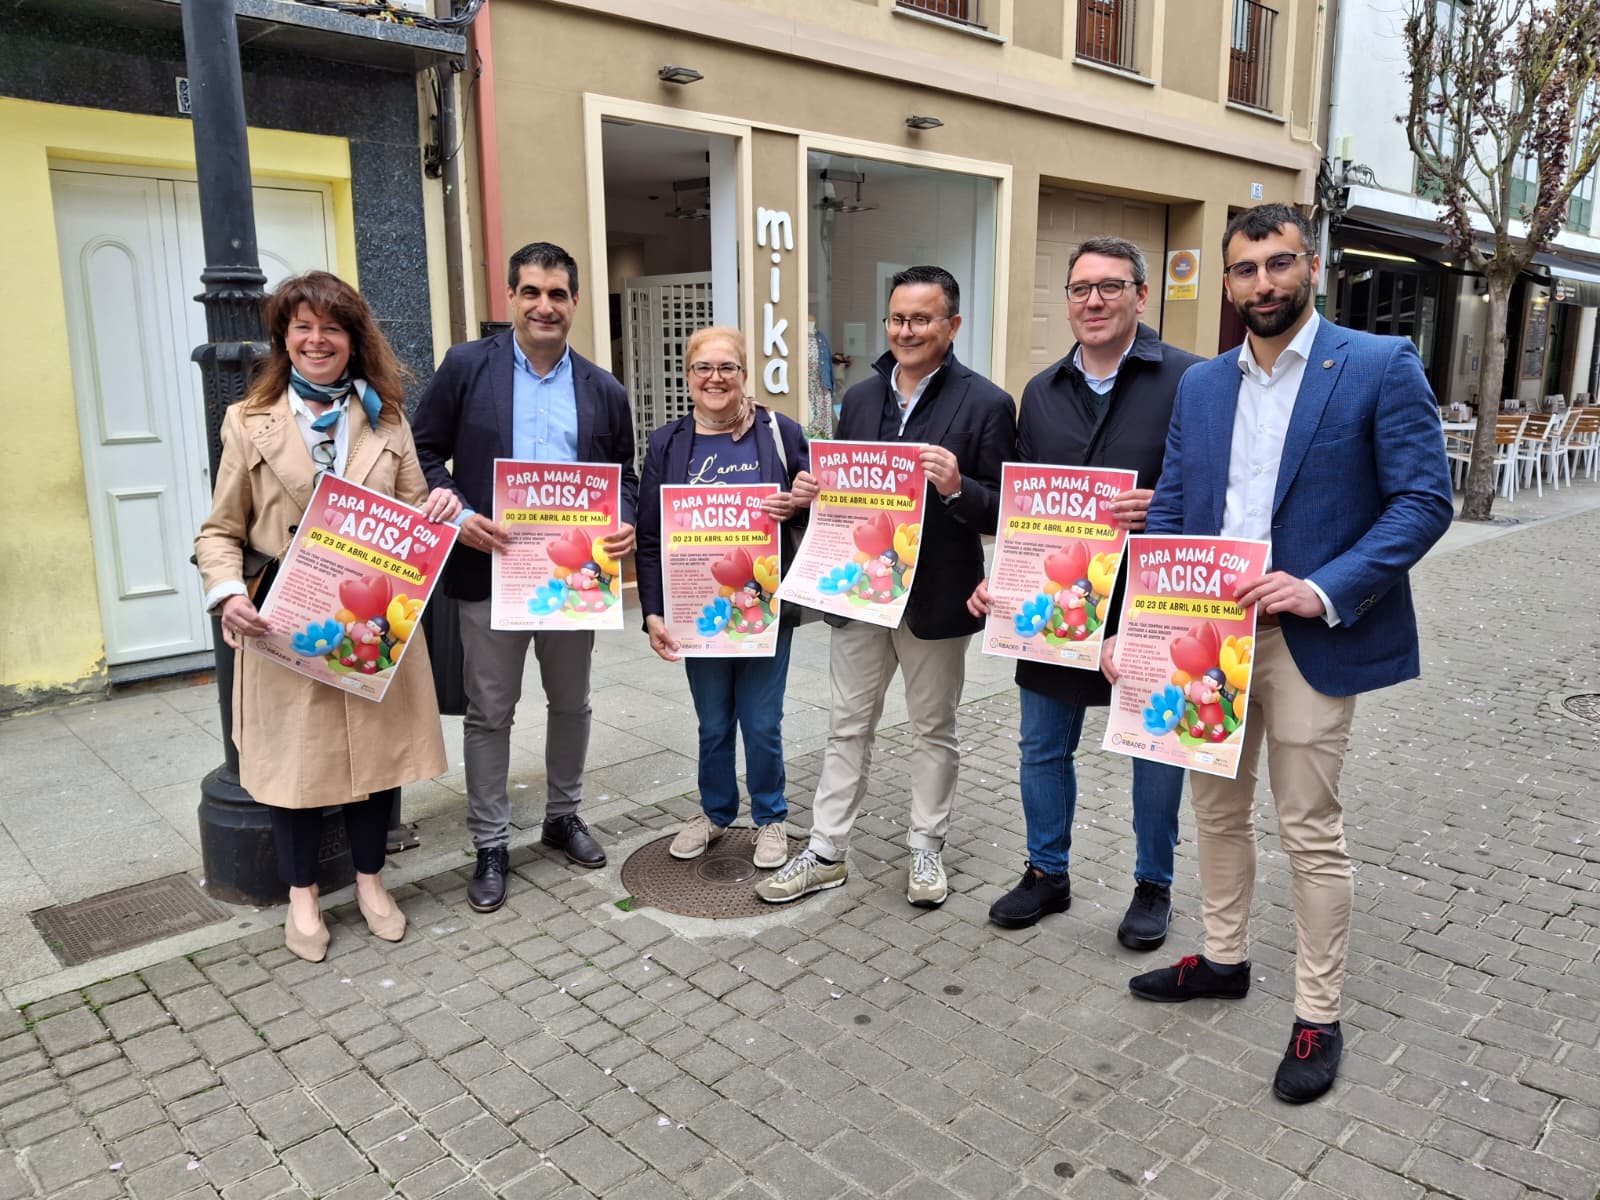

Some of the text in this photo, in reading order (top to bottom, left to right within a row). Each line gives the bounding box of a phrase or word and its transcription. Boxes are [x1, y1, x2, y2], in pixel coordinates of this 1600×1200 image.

[756, 206, 793, 395] mika
[819, 450, 915, 472] PARA MAMÁ CON
[506, 470, 608, 490] PARA MAMÁ CON
[837, 466, 896, 492] ACISA
[1014, 476, 1120, 498] PARA MAMÁ CON
[526, 485, 588, 509] ACISA
[672, 495, 702, 511] PARA
[707, 492, 741, 505] MAMÁ
[1031, 491, 1096, 521] ACISA
[328, 493, 440, 549] PARA MAMÁ CON
[692, 507, 750, 530] ACISA
[1043, 524, 1063, 532] ABRIL
[1096, 528, 1114, 536] MAIO
[339, 513, 413, 560] ACISA
[310, 531, 422, 581] DO 23 DE ABRIL AO 5 DE MAIO
[1139, 546, 1250, 573] PARA MAMÁ CON
[1157, 565, 1221, 598] ACISA
[1136, 599, 1145, 608] DO
[1159, 601, 1167, 609] DE
[1170, 602, 1189, 612] ABRIL
[1212, 606, 1220, 614] DE
[1223, 606, 1243, 615] MAIO
